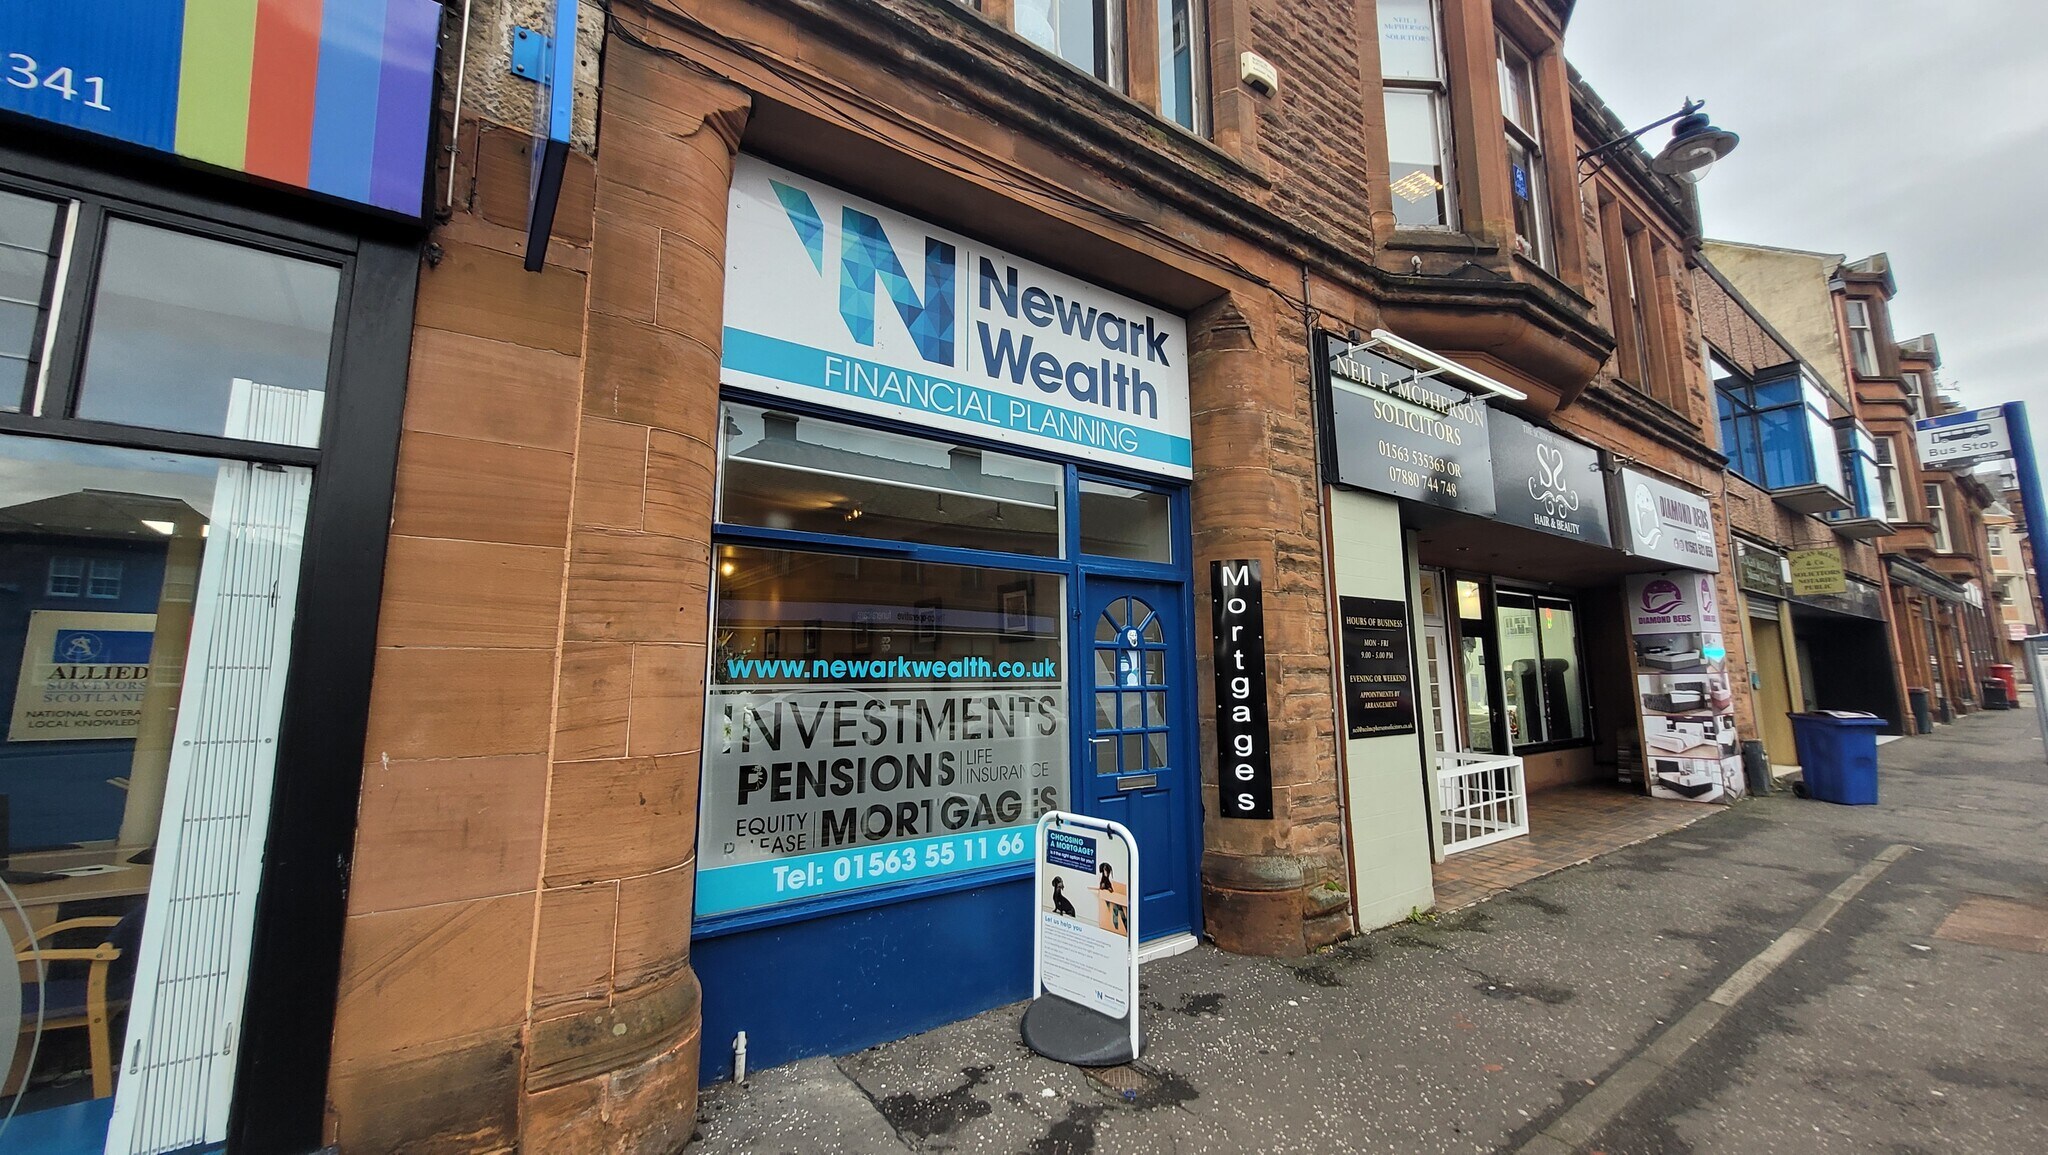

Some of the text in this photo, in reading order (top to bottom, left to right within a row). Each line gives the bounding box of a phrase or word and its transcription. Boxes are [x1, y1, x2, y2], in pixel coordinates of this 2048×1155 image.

[0, 52, 111, 111] 341
[978, 255, 1170, 367] Newark
[977, 320, 1158, 420] Wealth
[1335, 354, 1377, 388] NEIL
[1381, 371, 1393, 394] F.
[823, 355, 1139, 454] FINANCIAL PLANNING
[1373, 399, 1461, 446] SOLICITORS
[1378, 440, 1462, 478] 01563 535363 OR
[1929, 440, 1999, 457] Bus Stop
[1389, 465, 1457, 498] 07880 744 748
[1533, 513, 1580, 534] HAIR & BEAUTY
[1659, 496, 1709, 529] DIAMOND BEDS
[1346, 616, 1403, 627] HOURS OF BUSINESS
[1638, 615, 1671, 624] DIAMOND
[1364, 639, 1377, 647] MON
[47, 666, 149, 680] ALLIED
[727, 656, 1056, 679] www.newarkwealth.co.uk
[1382, 674, 1407, 682] WEEKEND
[46, 680, 146, 691] SURVEYORS
[1222, 565, 1256, 811] Mortgages
[26, 709, 90, 718] NATIONAL
[28, 721, 69, 729] LOCAL
[722, 695, 1057, 754] INVESTMENTS
[966, 748, 993, 766] LIFE
[738, 751, 956, 806] PENSIONS
[736, 812, 808, 837] EQUITY
[1050, 833, 1084, 846] CHOOSING
[1056, 842, 1094, 856] MORTGAGE?
[773, 832, 1025, 892] Tel: 01563 55 11 66
[1044, 915, 1052, 923] Let
[1061, 919, 1072, 929] help
[1073, 924, 1083, 932] you
